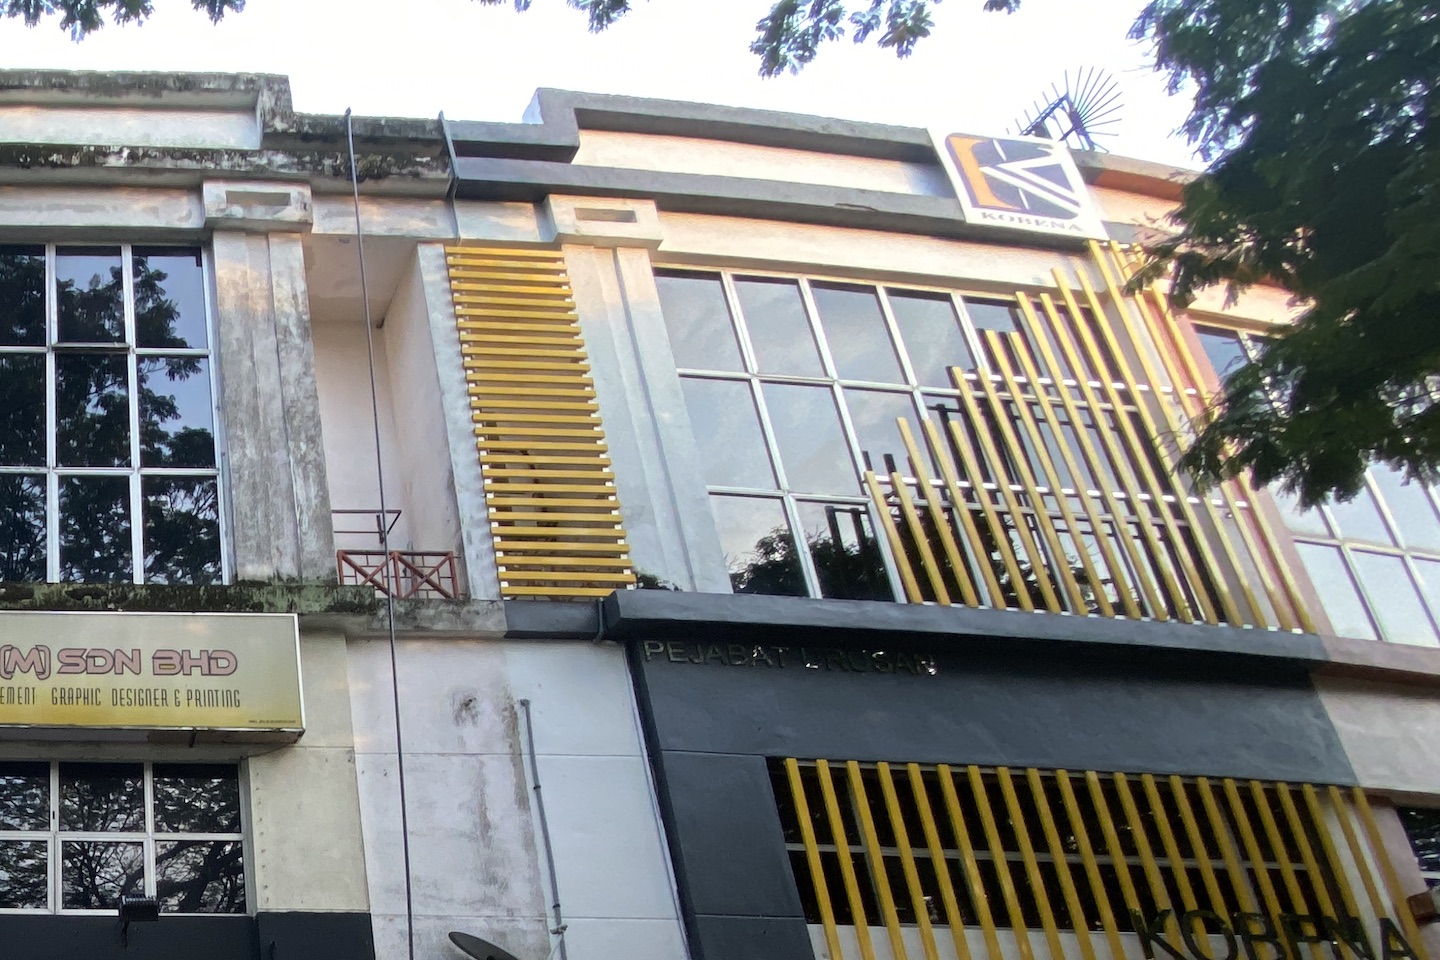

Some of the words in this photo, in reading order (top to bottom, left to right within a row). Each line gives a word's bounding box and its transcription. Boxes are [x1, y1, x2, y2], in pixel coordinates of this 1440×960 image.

[981, 210, 1085, 233] KOBENA
[56, 647, 142, 676] SDN
[151, 648, 239, 677] BHD
[643, 640, 789, 669] PEJABAT
[51, 687, 103, 707] GRAPHIC
[111, 688, 168, 708] DESIGNER
[186, 689, 241, 709] PRINTING
